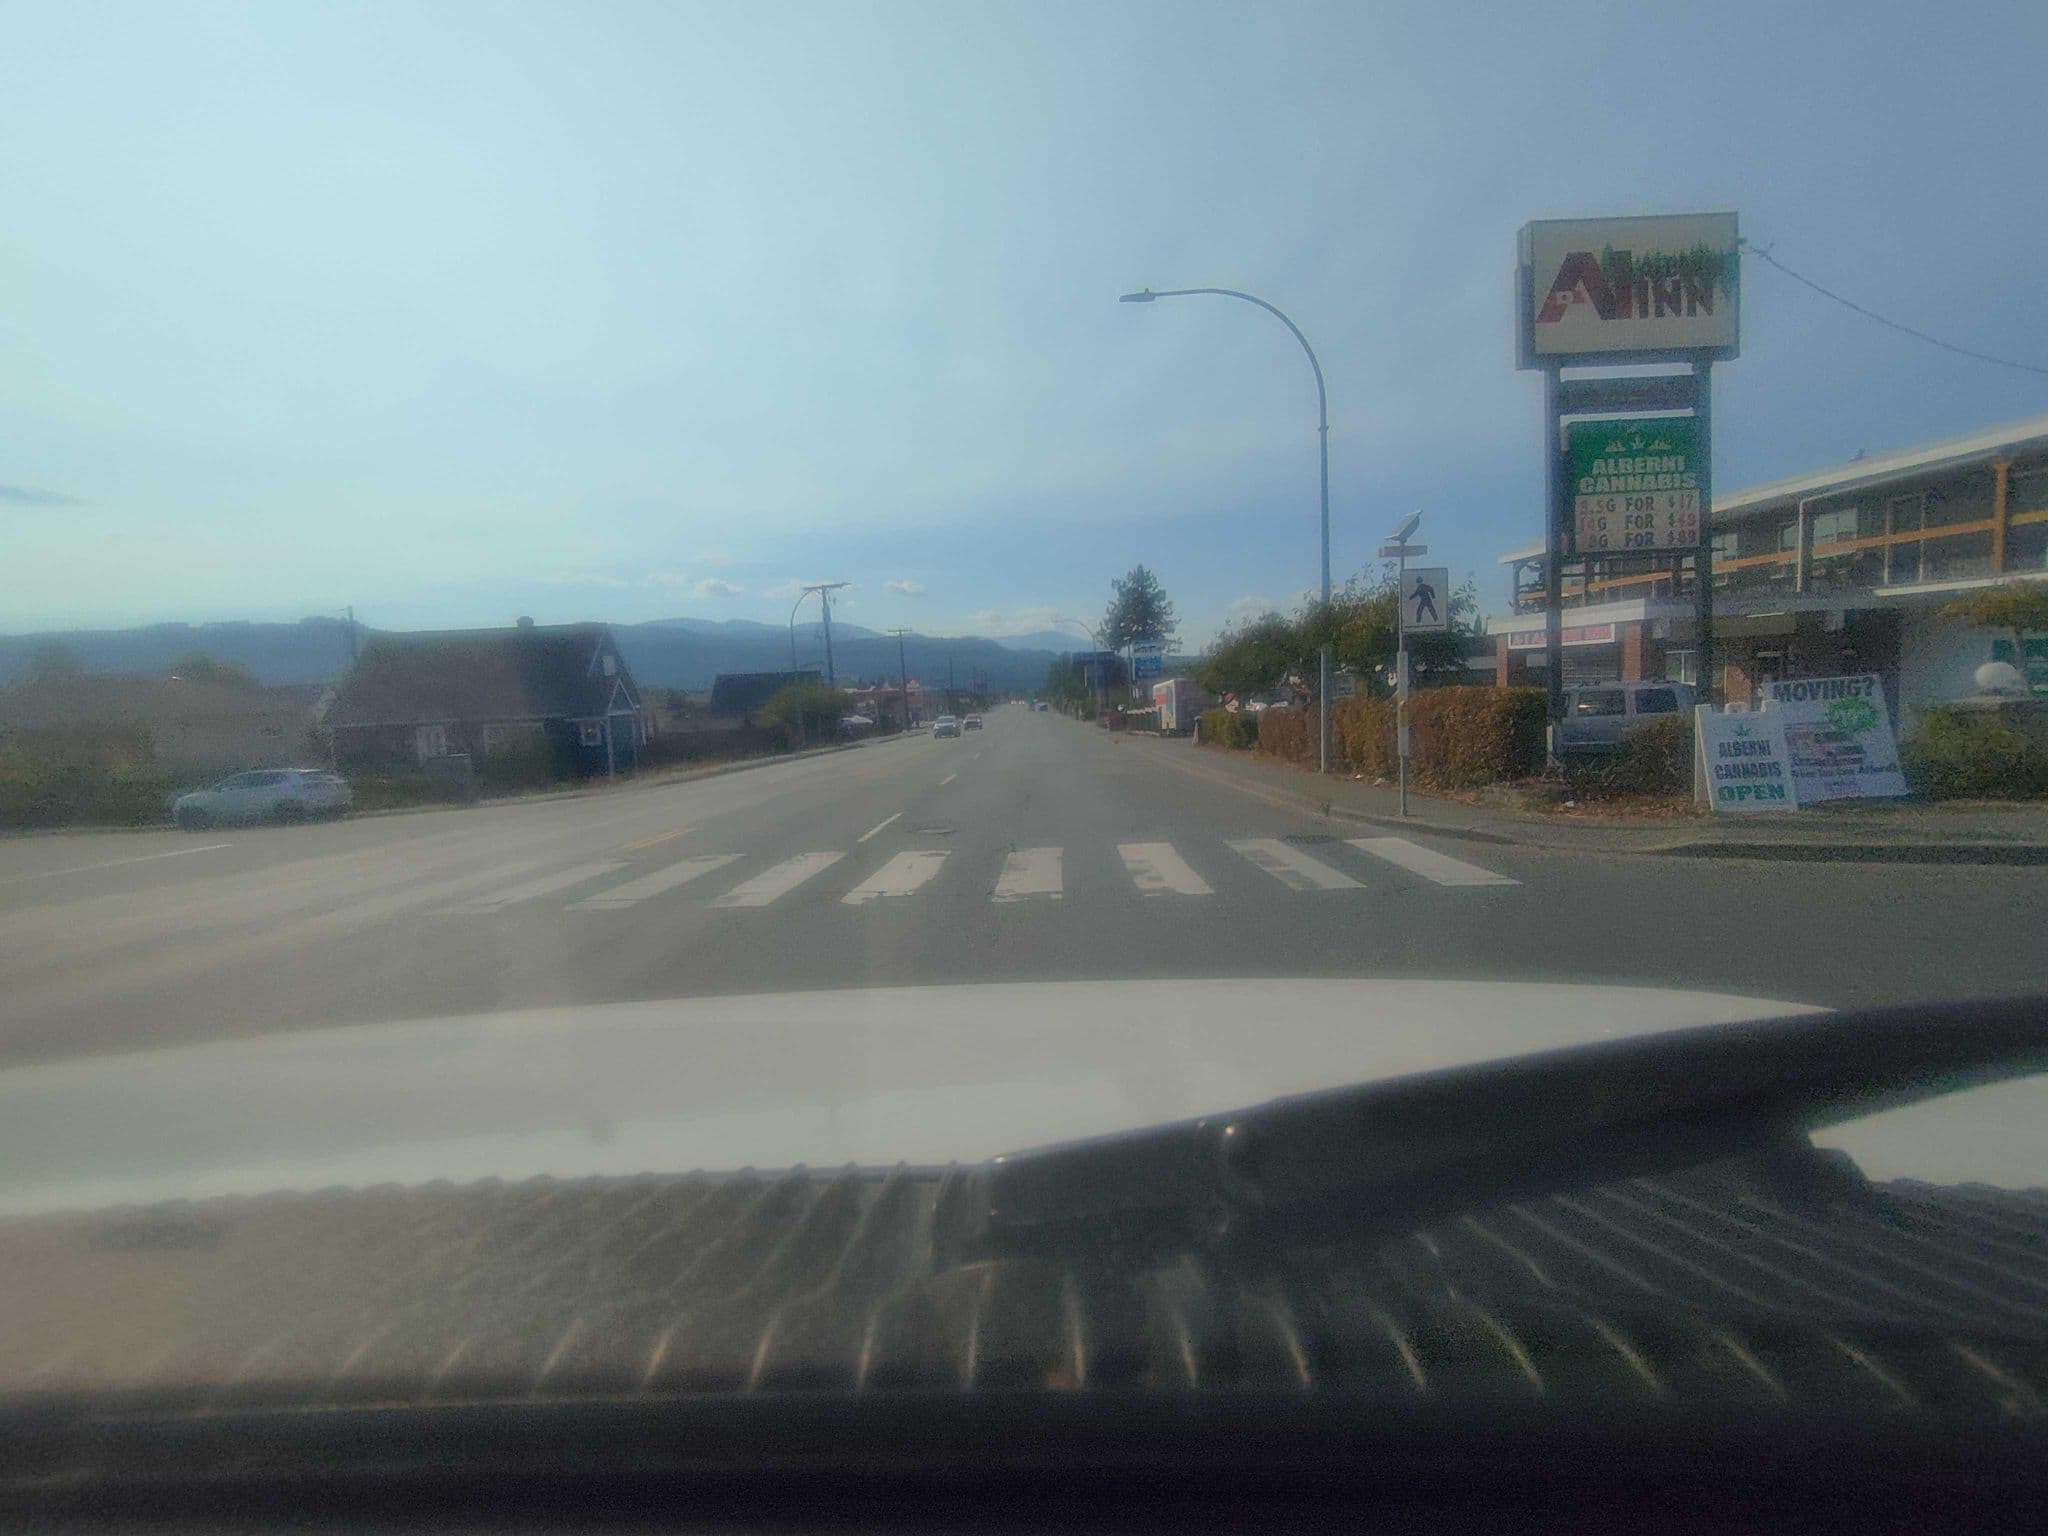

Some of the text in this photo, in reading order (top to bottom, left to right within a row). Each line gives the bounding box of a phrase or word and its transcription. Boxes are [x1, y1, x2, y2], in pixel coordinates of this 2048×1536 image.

[1592, 456, 1684, 475] ALBERNI
[1580, 472, 1697, 494] CANNABIS
[1625, 496, 1654, 511] FOR
[1625, 514, 1654, 529] FOR
[1625, 531, 1654, 547] FOR
[1773, 676, 1875, 703] MOVING?
[1719, 739, 1771, 759] ALBERNI
[1714, 760, 1781, 781] CANNABIS
[1718, 782, 1785, 802] OPEN
